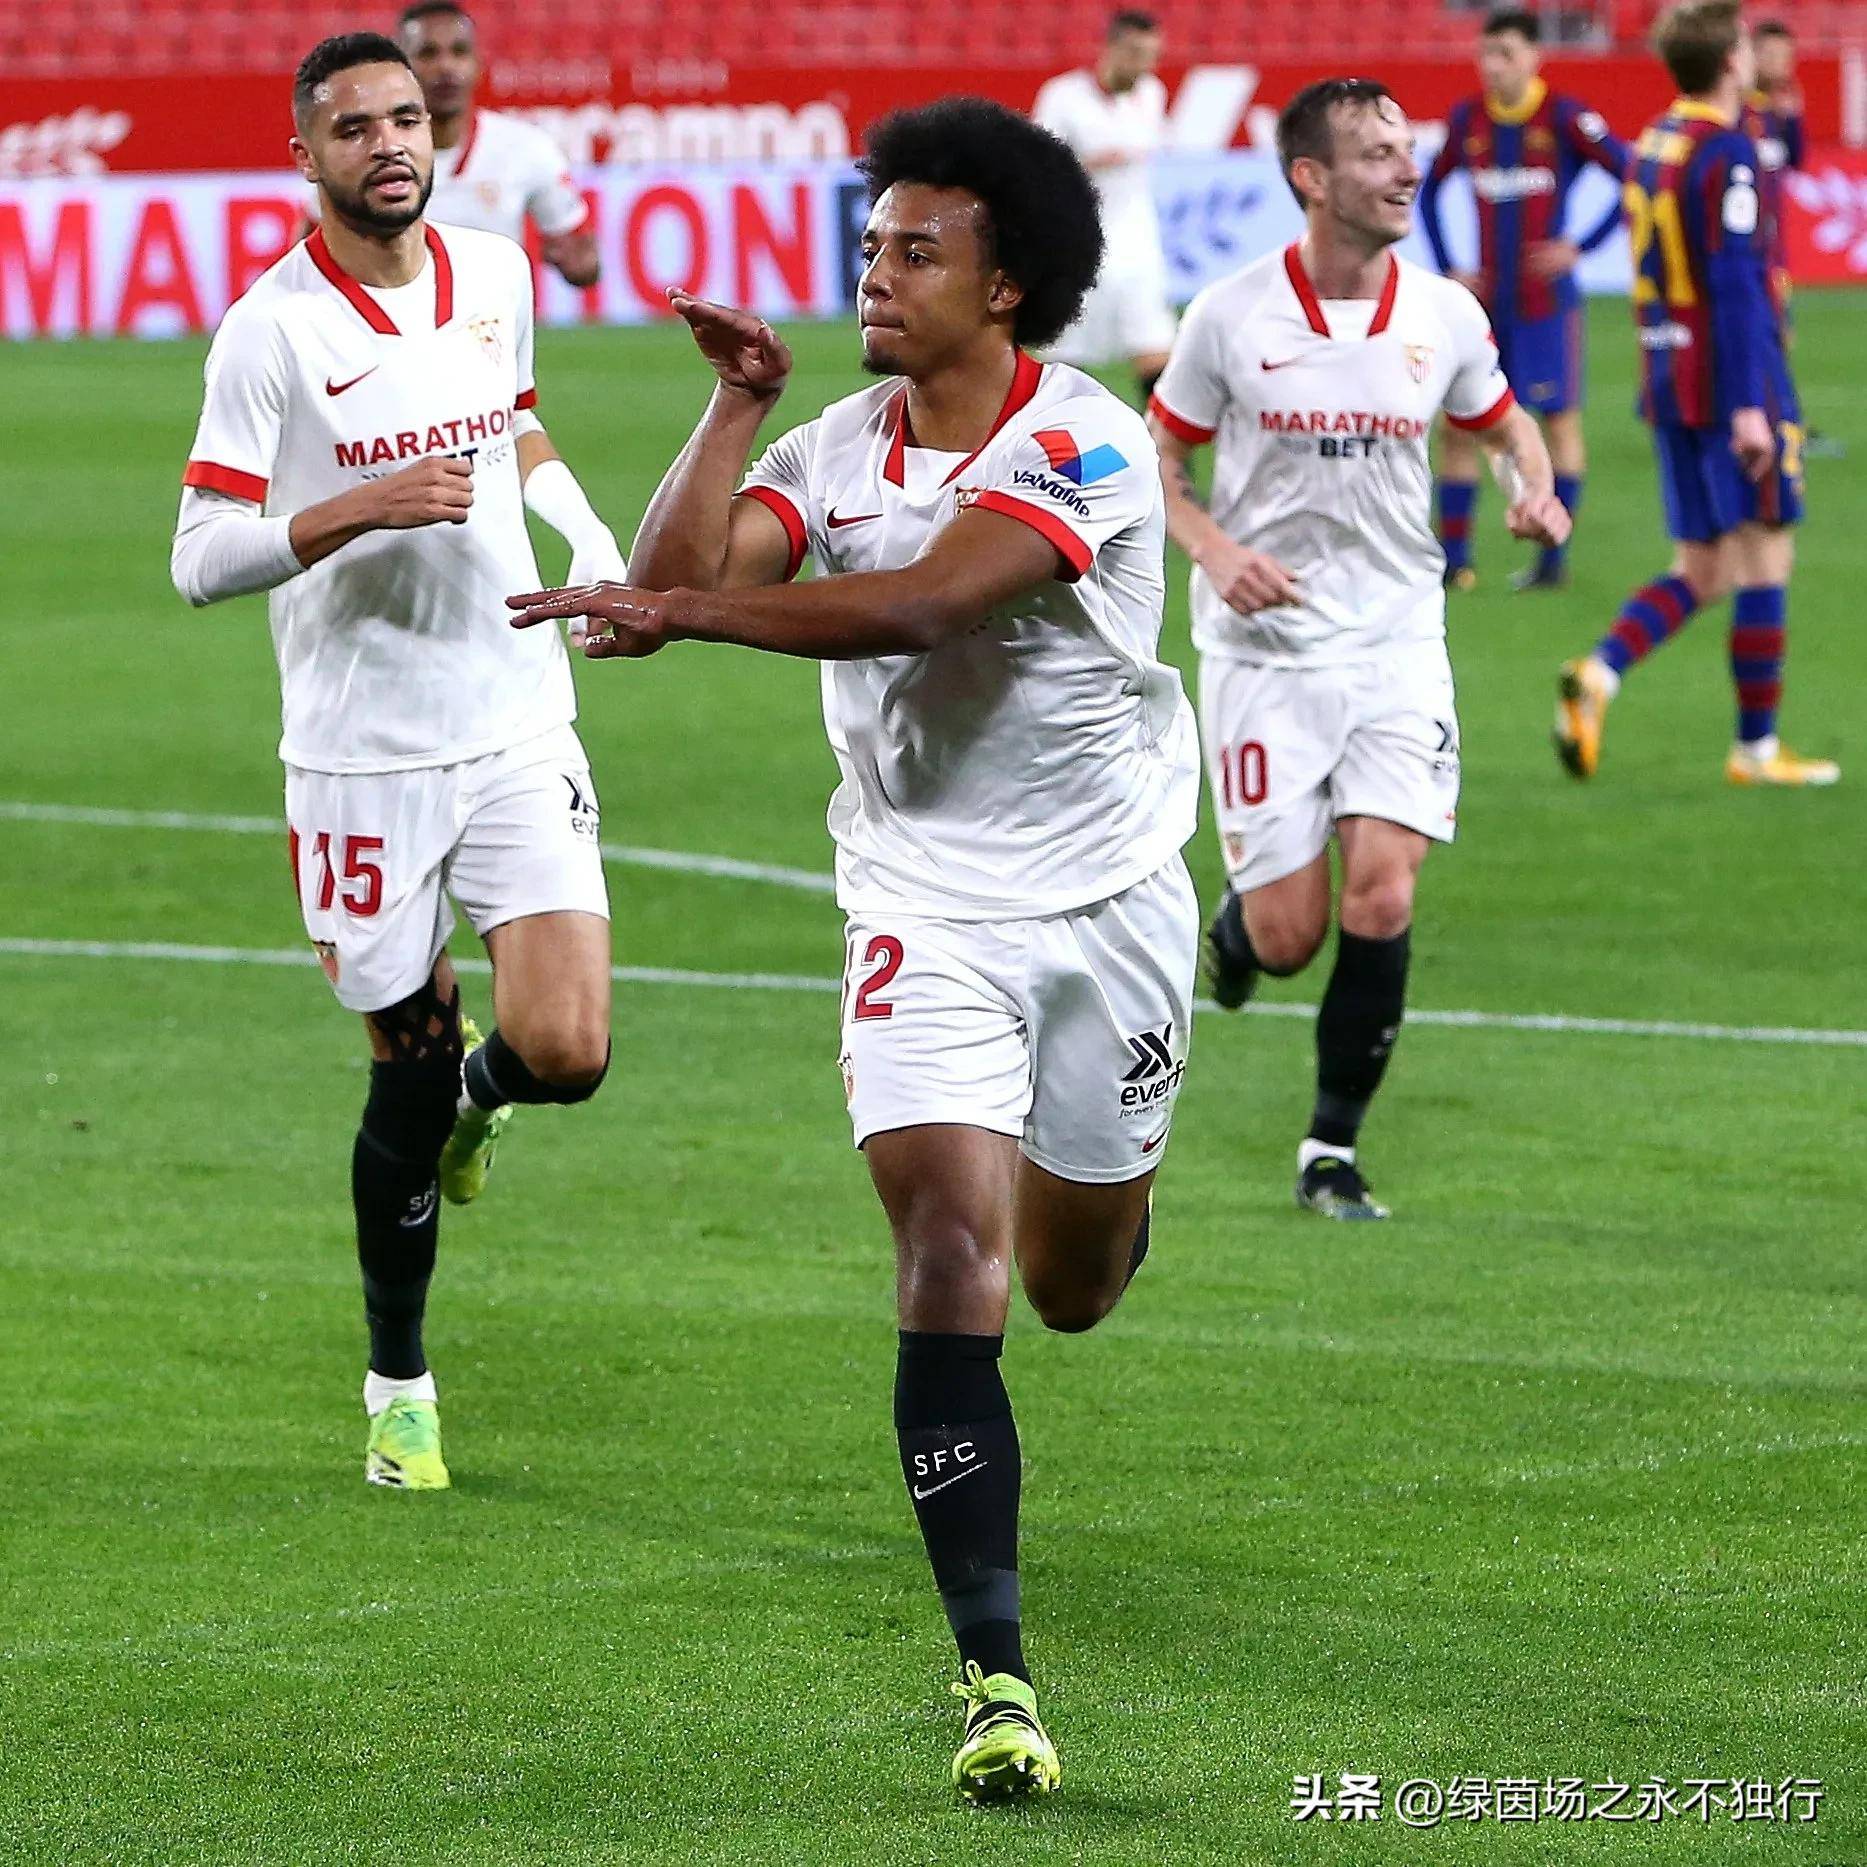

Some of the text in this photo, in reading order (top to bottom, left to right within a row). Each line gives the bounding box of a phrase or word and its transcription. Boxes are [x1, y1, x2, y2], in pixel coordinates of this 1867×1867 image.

[1622, 180, 1698, 306] 21
[1320, 437, 1378, 458] BET
[1221, 739, 1268, 810] 10
[312, 831, 384, 917] 15
[846, 934, 904, 1023] 2
[913, 1441, 976, 1476] SFC
